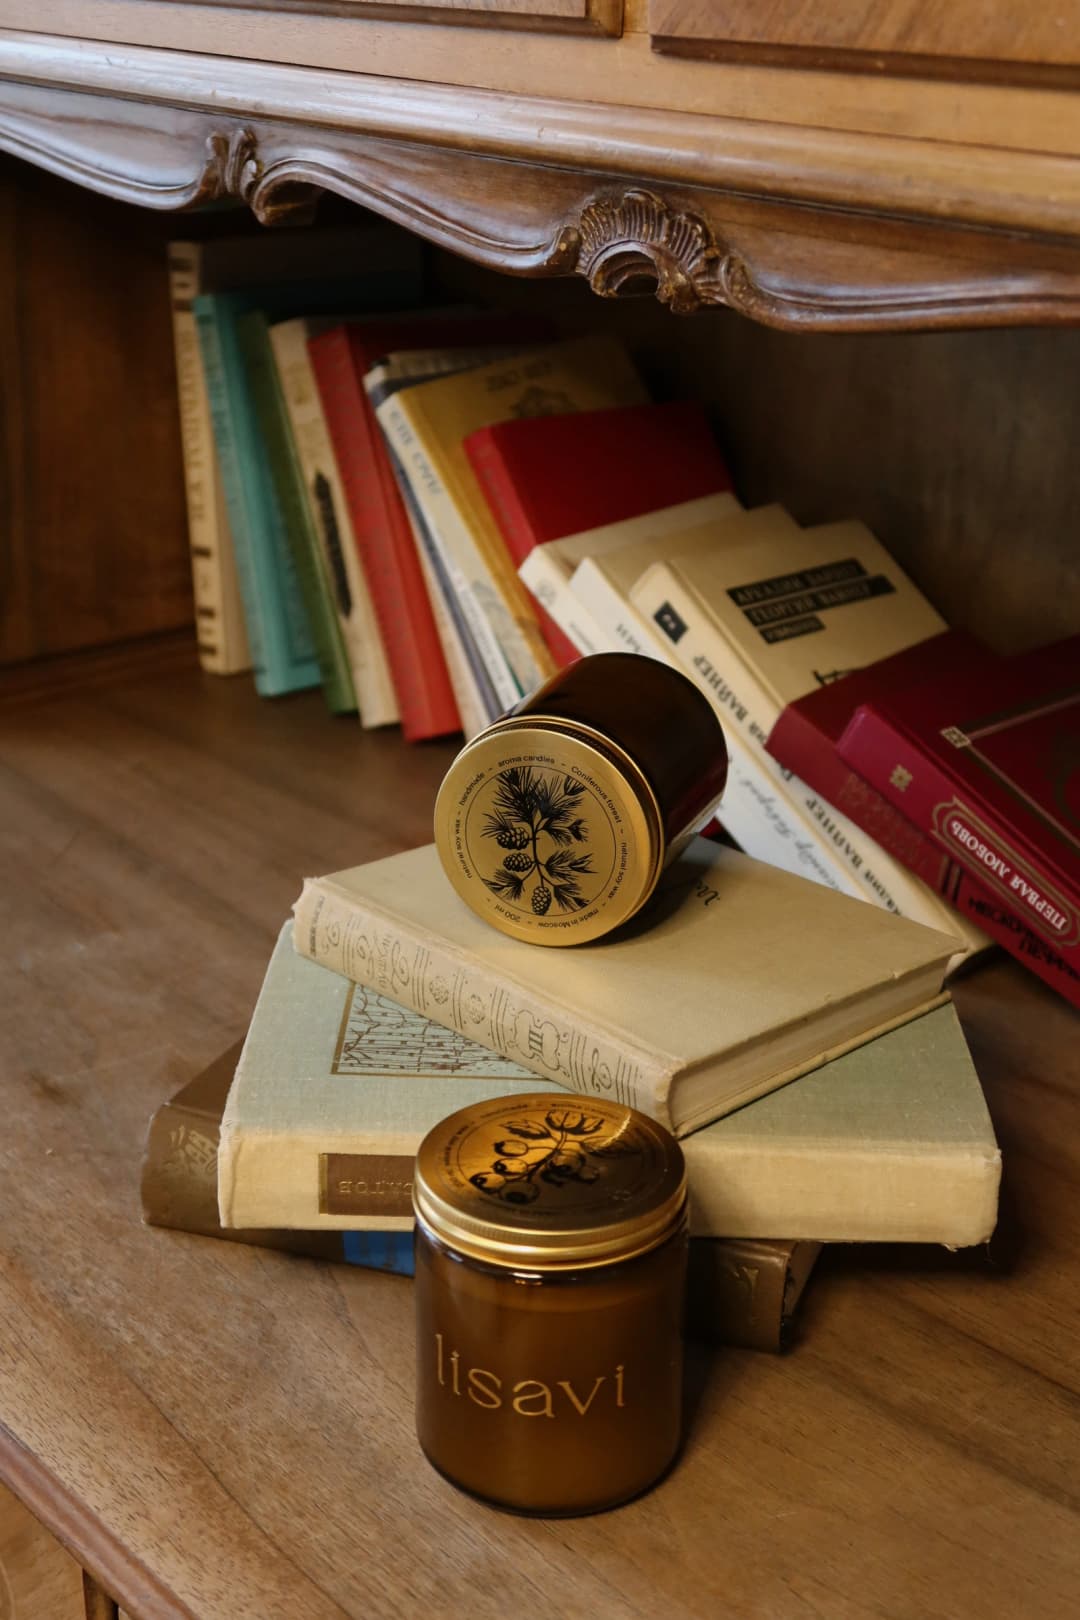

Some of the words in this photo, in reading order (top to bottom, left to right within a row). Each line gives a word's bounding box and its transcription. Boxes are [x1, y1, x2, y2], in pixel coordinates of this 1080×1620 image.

[693, 655, 749, 722] ВАЙНЕР
[498, 757, 521, 767] aroma
[522, 755, 556, 764] candles
[459, 772, 485, 806] handmade
[571, 766, 608, 800] Coniferous
[606, 799, 622, 823] forest
[806, 799, 862, 869] ВАЙНЕР
[620, 842, 628, 871] natural
[950, 820, 1011, 878] ЛЮБОВЬ
[457, 851, 472, 879] natural
[615, 871, 625, 885] soy
[608, 886, 619, 898] wax
[1009, 874, 1067, 930] ПЕРВАЯ
[494, 903, 504, 913] ml
[503, 911, 521, 922] 200
[579, 908, 599, 920] made
[435, 1333, 625, 1418] lisavi
